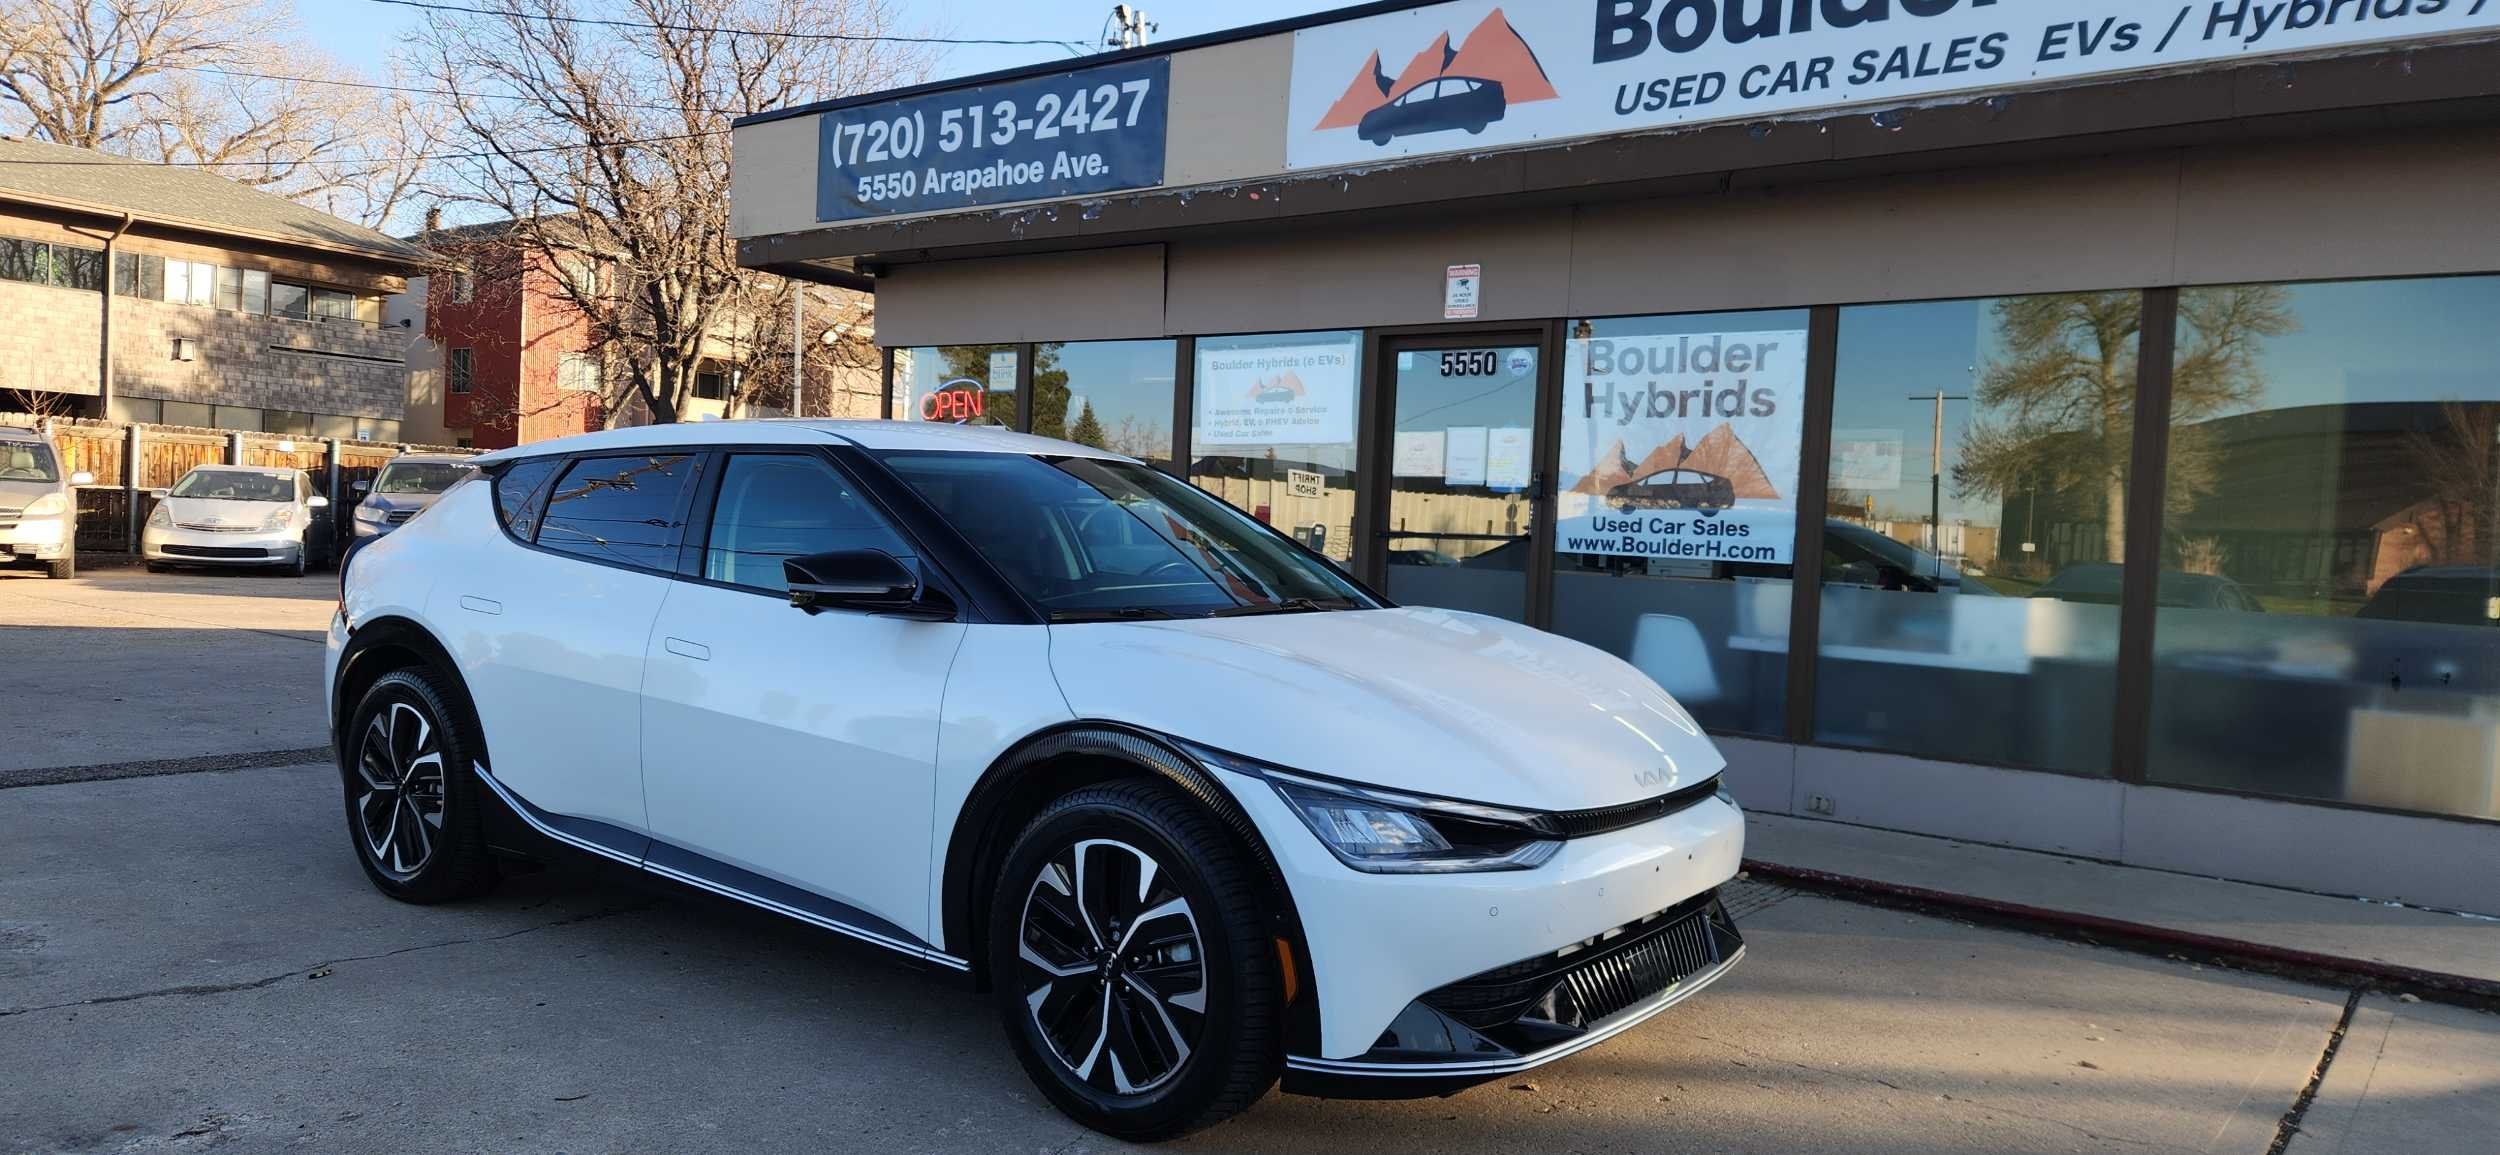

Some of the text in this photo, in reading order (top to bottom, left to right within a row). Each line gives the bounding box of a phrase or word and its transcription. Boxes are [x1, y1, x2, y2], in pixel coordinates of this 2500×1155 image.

[1614, 71, 1726, 115] USED
[1738, 56, 1834, 99] CAR
[1847, 32, 2009, 86] SALES
[2036, 16, 2142, 62] EVs
[2153, 5, 2192, 53] /
[832, 78, 1150, 169] (720) 513-2427
[856, 151, 1109, 202] 5550 Arapahoe Ave.
[1212, 359, 1253, 371] Boulder
[1257, 357, 1298, 371] Hybrids
[1440, 351, 1497, 377] 5550
[1586, 335, 1779, 377] Boulder
[919, 389, 983, 420] OPEN
[1583, 379, 1777, 426] Hybrids
[1592, 516, 1750, 537] Used Car Sales
[1568, 536, 1776, 560] www.BoulderH.com
